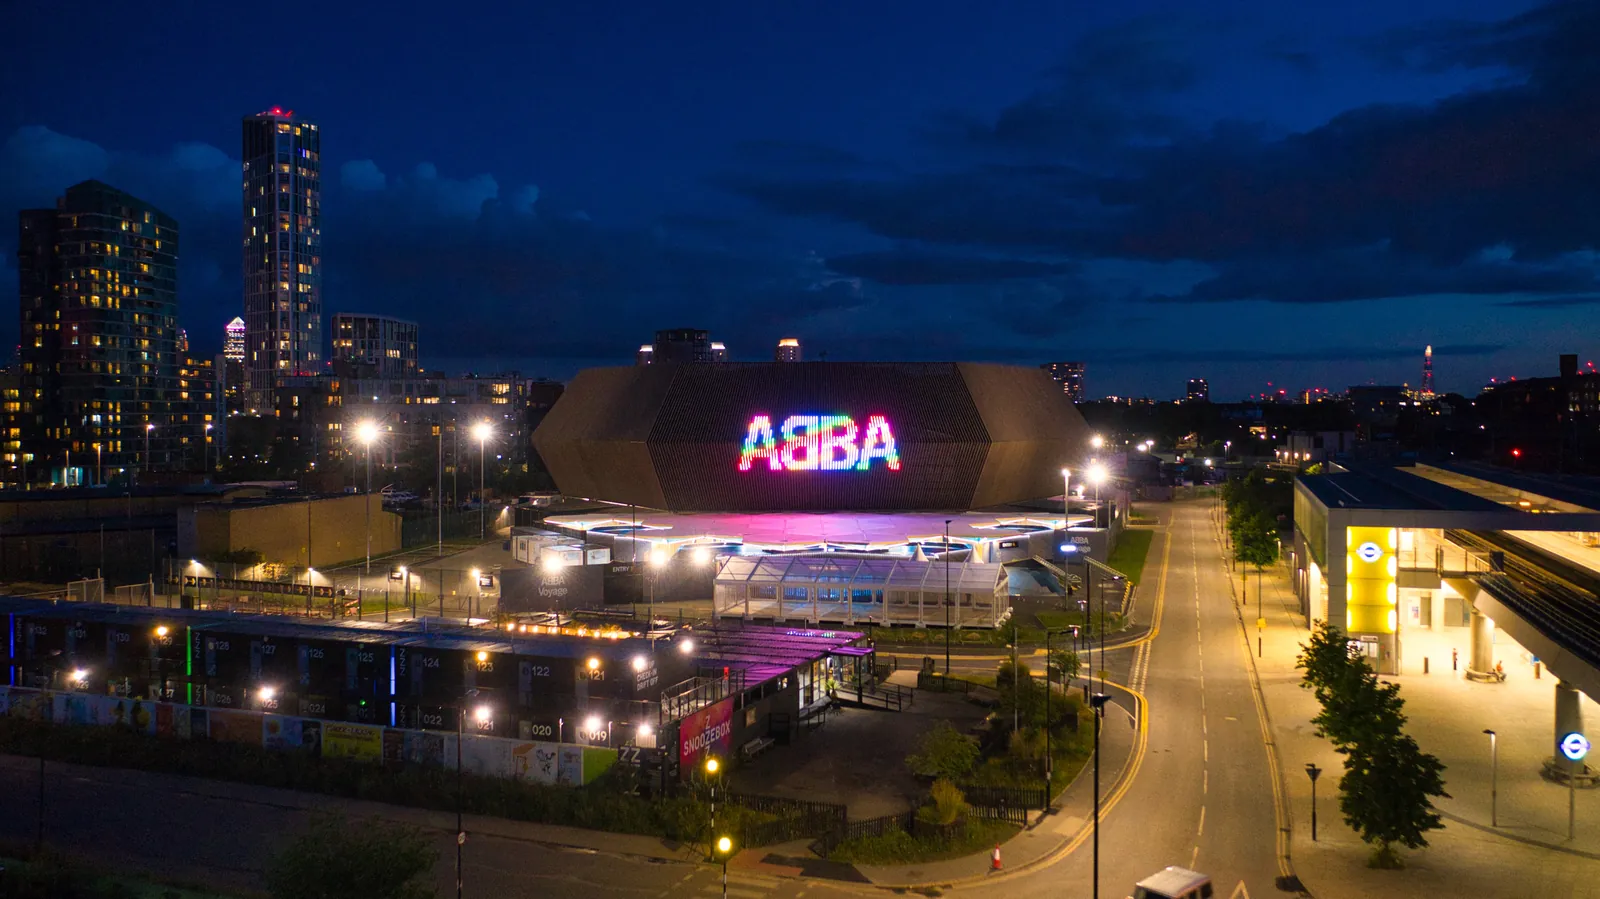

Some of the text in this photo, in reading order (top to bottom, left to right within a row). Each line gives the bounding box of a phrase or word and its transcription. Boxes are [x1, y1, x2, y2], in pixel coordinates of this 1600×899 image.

[739, 414, 900, 471] ABBA
[541, 576, 565, 586] ABBA
[538, 587, 568, 597] Voyage
[116, 633, 130, 642] 130
[215, 641, 230, 651] 128
[261, 644, 276, 655] 127
[308, 648, 325, 659] 126
[357, 652, 375, 663] 125
[423, 657, 440, 668] 124
[476, 662, 494, 672] 123
[532, 665, 550, 677] 122
[588, 670, 605, 681] 121
[215, 694, 232, 704] 026
[263, 699, 279, 709] 025
[309, 704, 326, 714] 024
[423, 714, 443, 725] 022
[477, 720, 495, 730] 021
[532, 725, 552, 736] 020
[589, 731, 607, 741] 019
[683, 720, 731, 756] SNOOZEBOX
